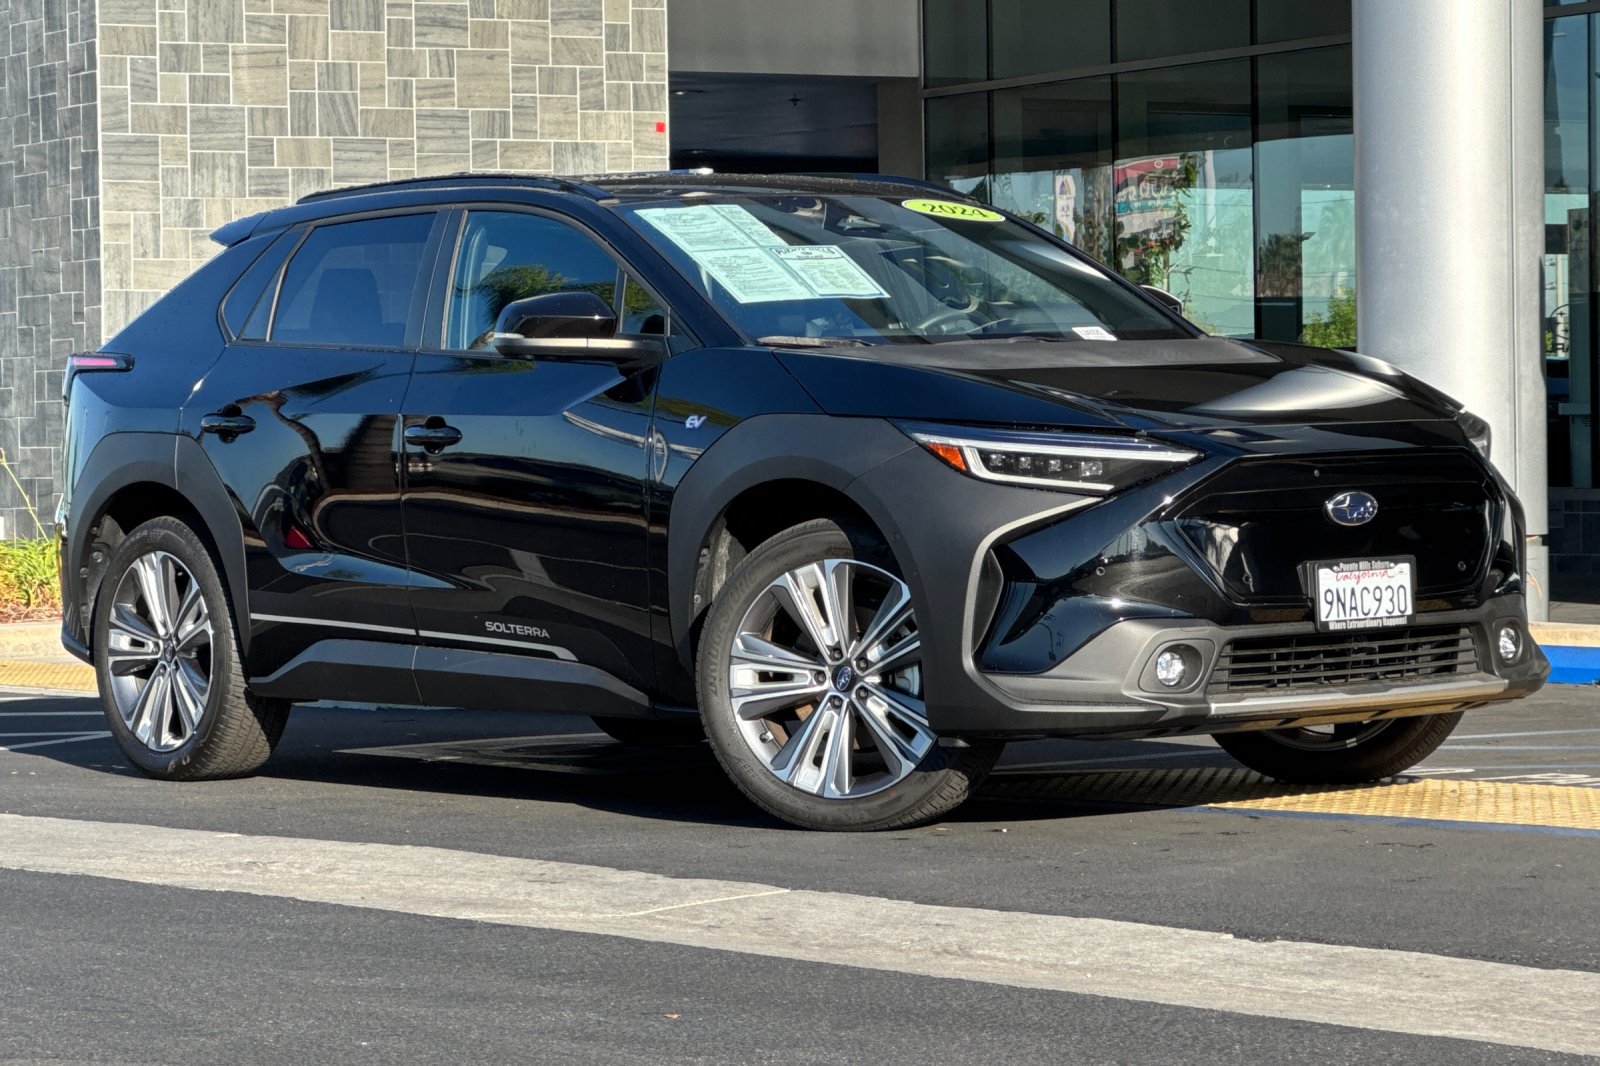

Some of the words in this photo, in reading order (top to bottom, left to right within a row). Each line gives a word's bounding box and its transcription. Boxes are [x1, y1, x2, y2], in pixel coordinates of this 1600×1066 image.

[922, 203, 988, 217] 2024
[685, 414, 707, 429] EV
[1336, 570, 1394, 585] California
[1324, 584, 1407, 618] 9NAC930
[485, 621, 550, 638] SOLTERRA
[1329, 621, 1346, 630] Where
[1346, 618, 1382, 629] Extraordinary
